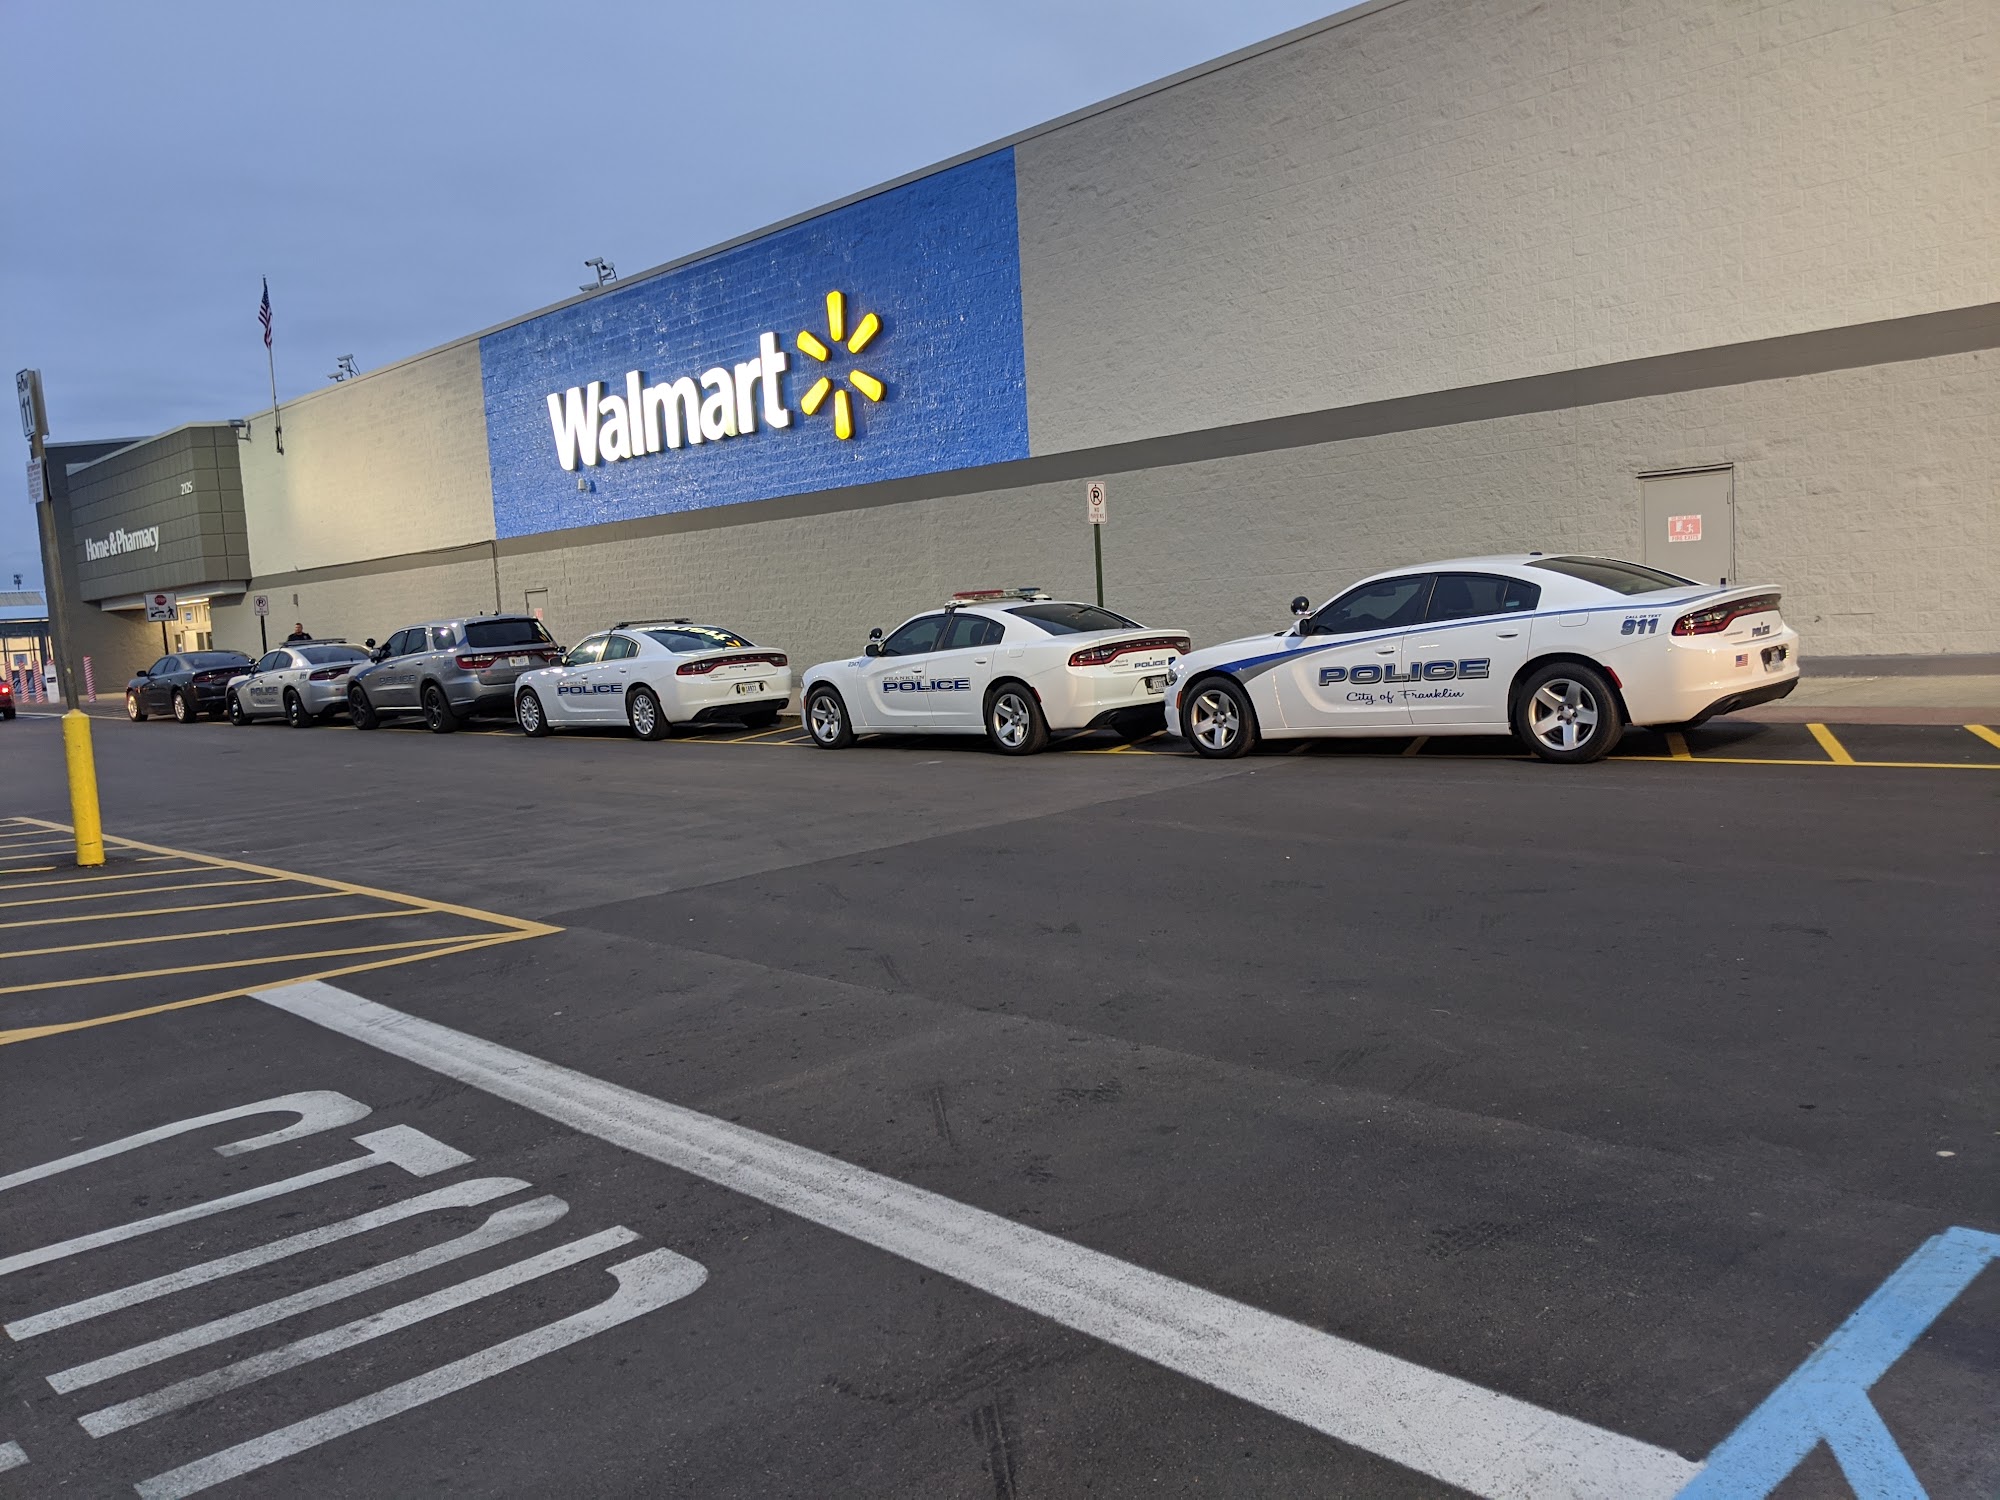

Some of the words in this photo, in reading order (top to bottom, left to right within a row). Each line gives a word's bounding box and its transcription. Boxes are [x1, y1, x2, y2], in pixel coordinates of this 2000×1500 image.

[546, 331, 794, 472] Walmart
[21, 395, 34, 428] 11
[85, 538, 110, 561] Home
[116, 526, 159, 553] Pharmacy
[1621, 618, 1659, 635] 911
[1751, 625, 1771, 638] POLICE
[1134, 660, 1166, 668] POLICE
[1319, 658, 1490, 686] POLICE
[379, 674, 416, 686] POLICE
[882, 677, 971, 693] POLICE
[250, 686, 279, 697] POLICE
[557, 683, 623, 696] POLICE
[1346, 691, 1377, 705] City
[1379, 691, 1394, 704] of
[1397, 688, 1465, 700] Franklin
